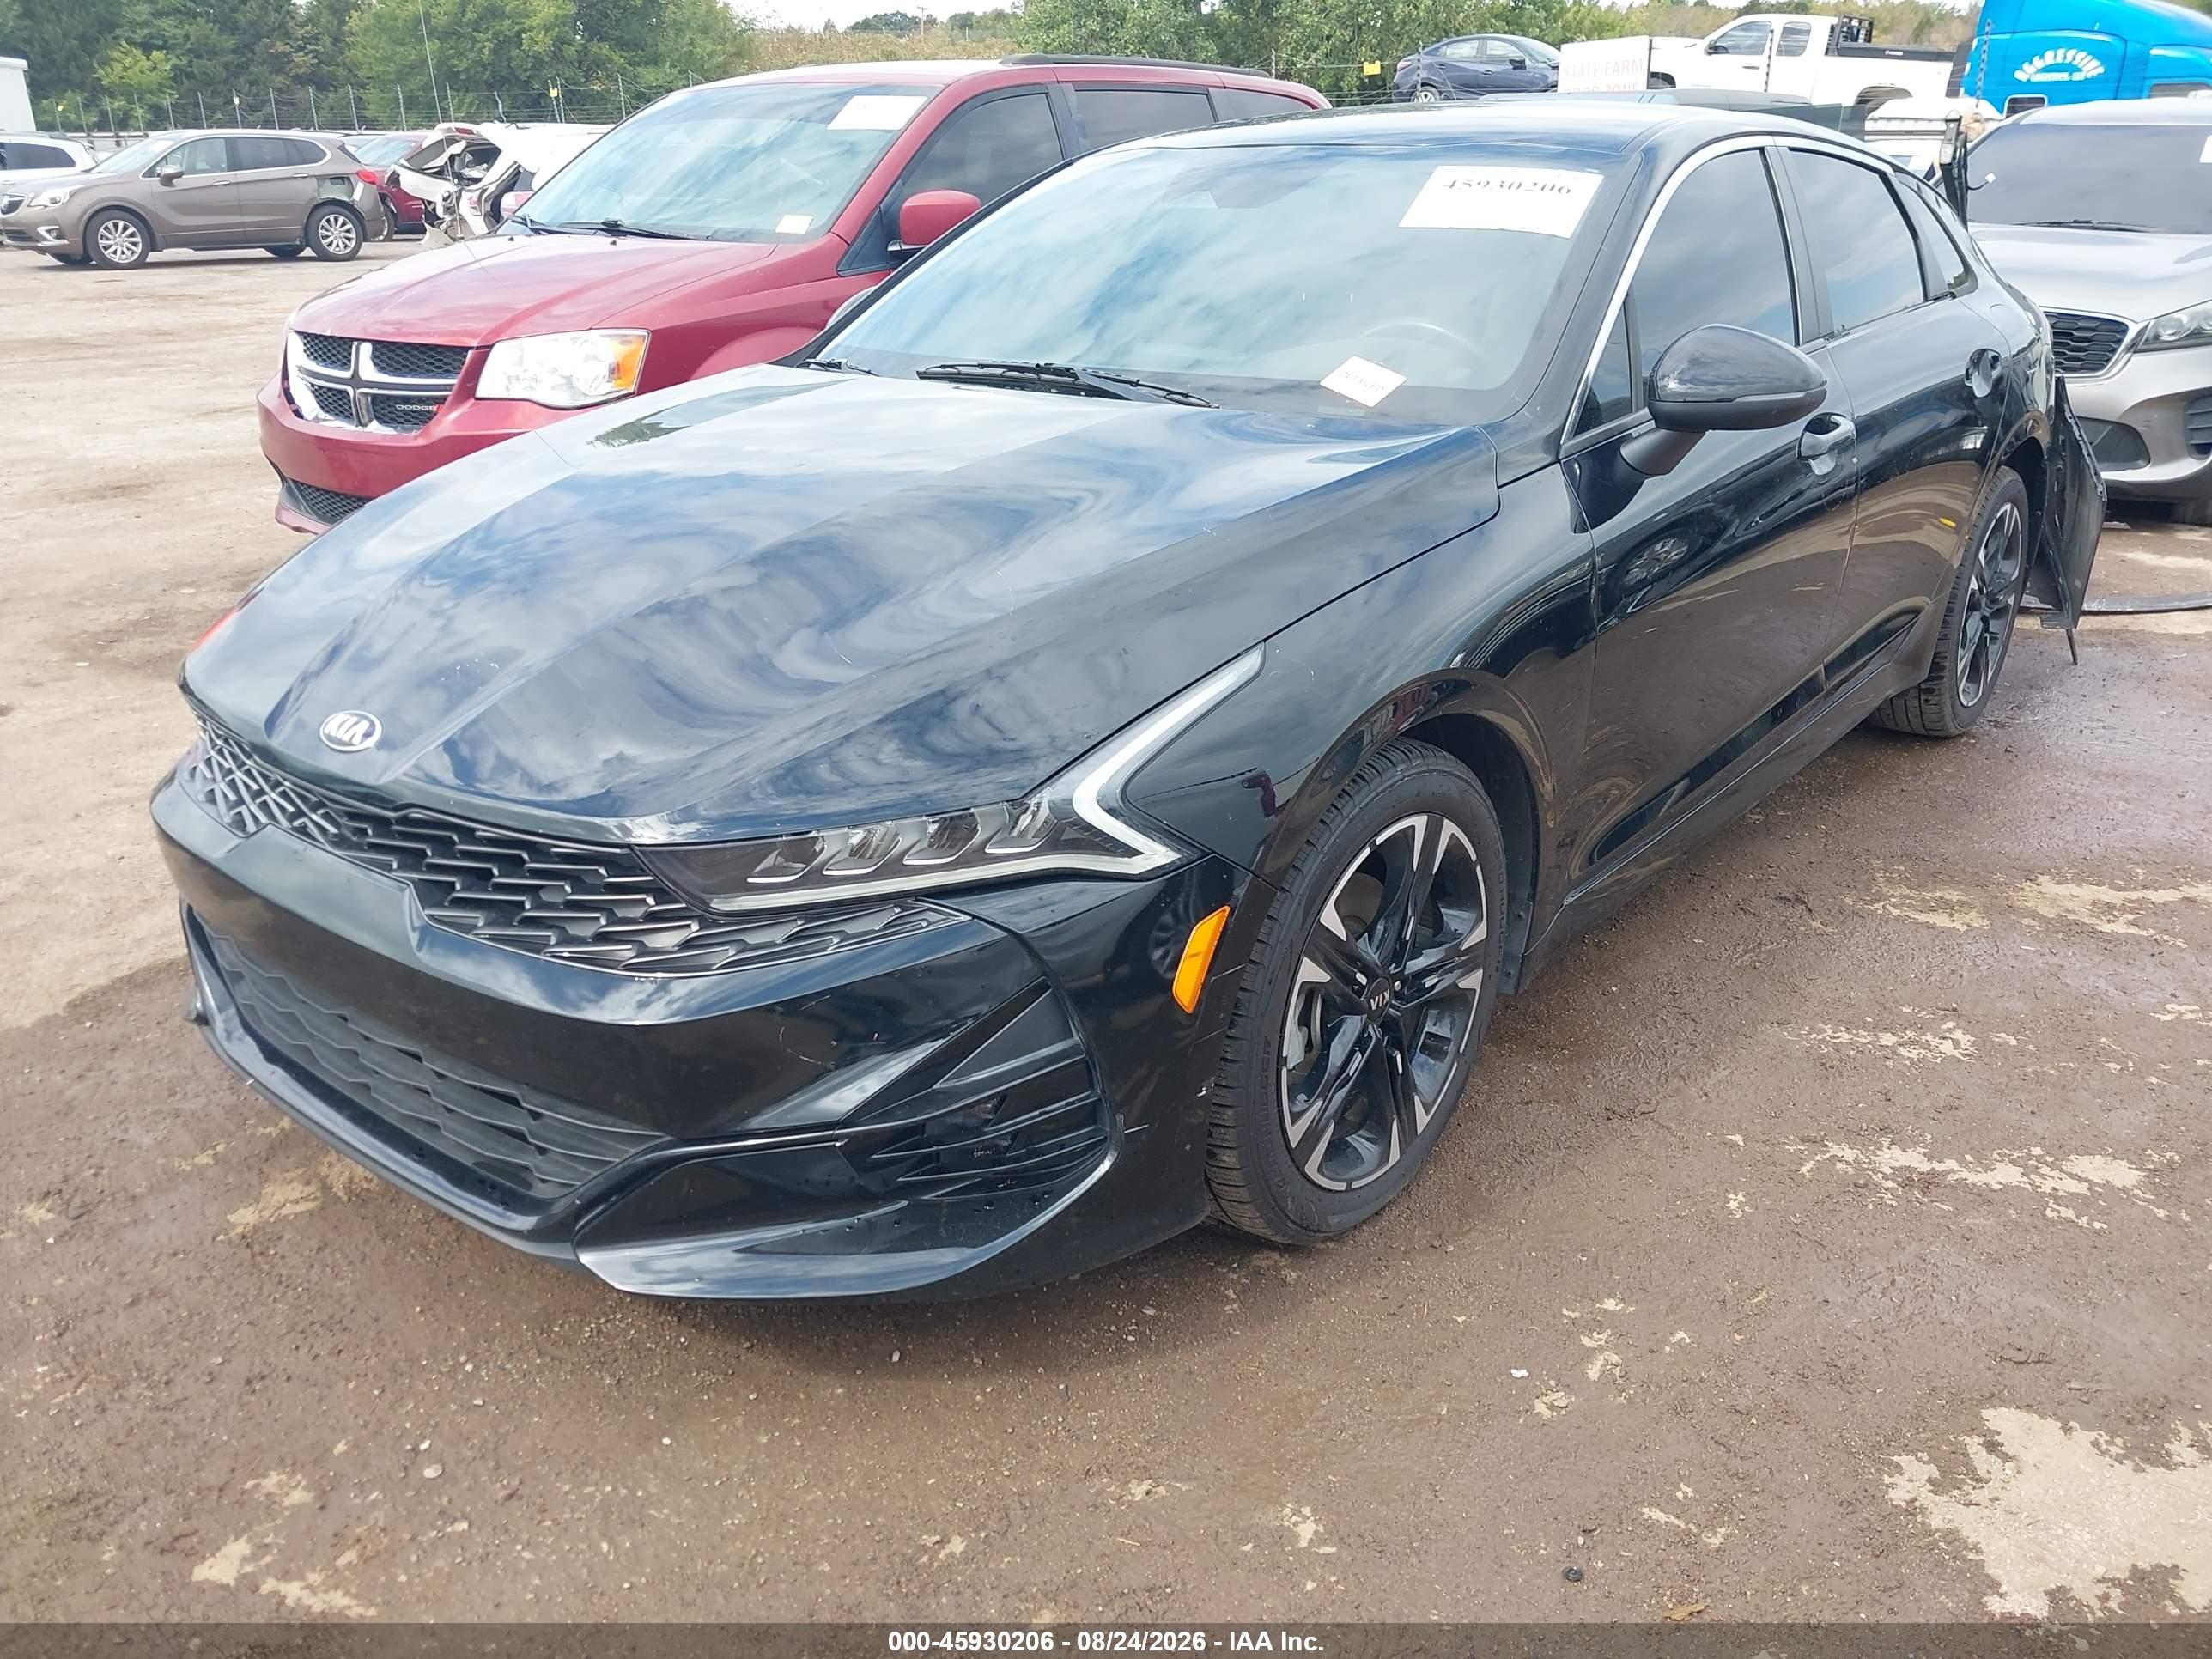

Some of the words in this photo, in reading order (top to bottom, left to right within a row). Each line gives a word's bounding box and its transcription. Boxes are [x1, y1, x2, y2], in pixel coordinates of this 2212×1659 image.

[1563, 62, 1601, 79] STATE
[1605, 58, 1643, 76] FARM
[323, 714, 371, 746] KIA
[1370, 988, 1390, 1011] KIA
